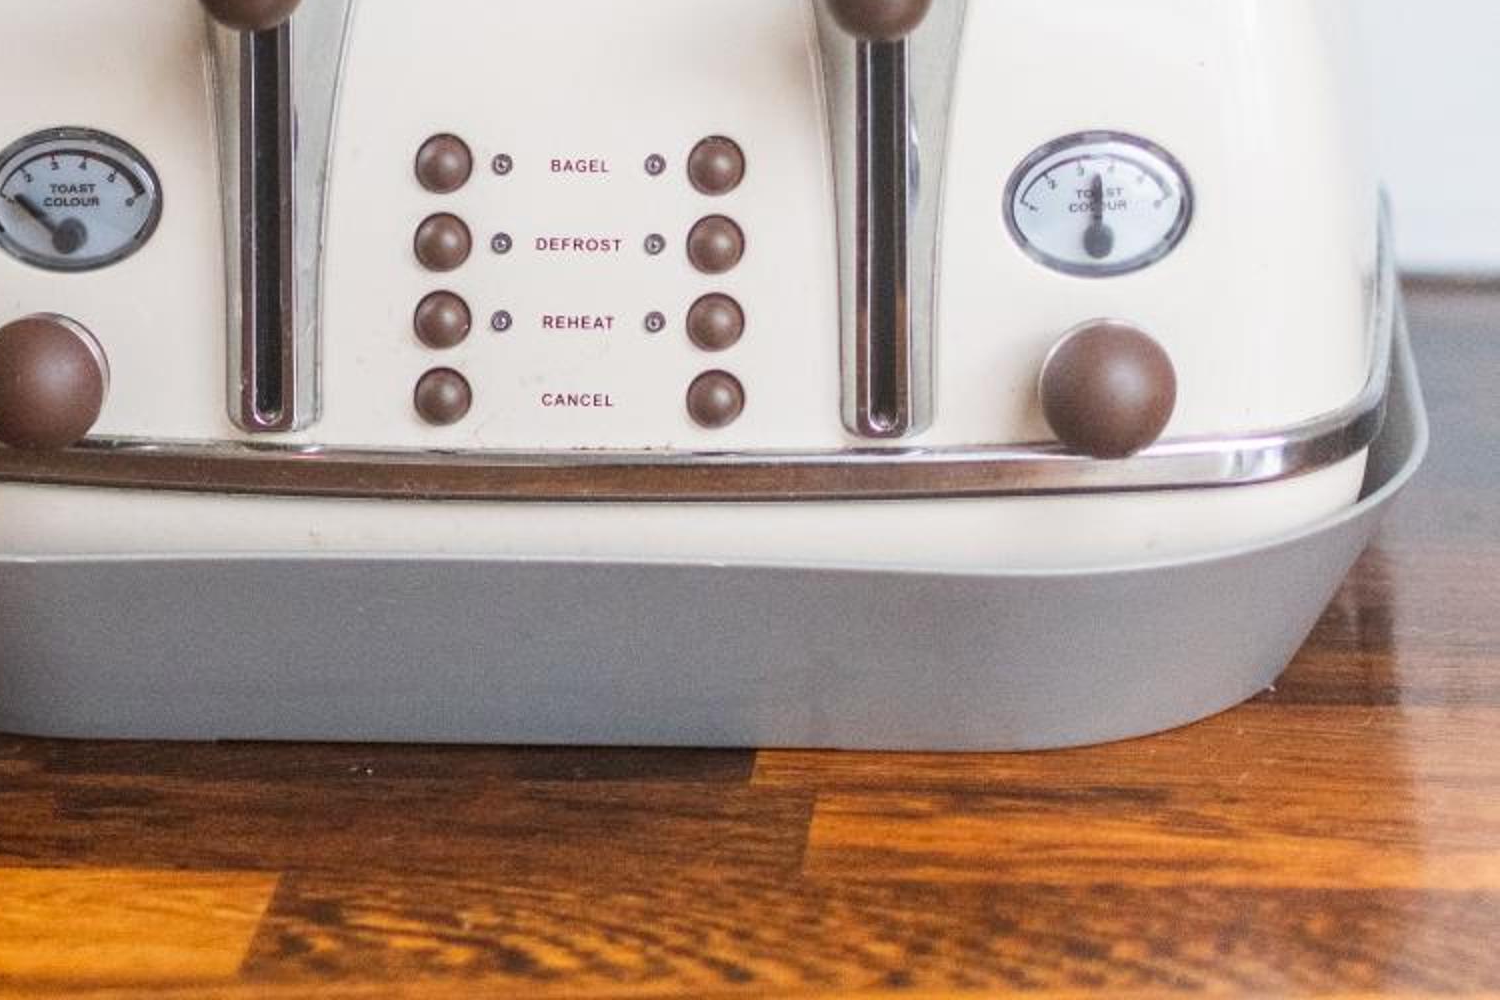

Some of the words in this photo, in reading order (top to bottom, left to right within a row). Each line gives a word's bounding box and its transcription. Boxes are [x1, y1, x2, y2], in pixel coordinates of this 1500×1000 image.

[550, 159, 610, 173] BAGEL
[49, 183, 97, 194] TOAST
[1075, 187, 1125, 199] TOST
[42, 196, 100, 208] COLOUR
[535, 237, 622, 251] DEFROST
[542, 315, 615, 329] REHEAT
[541, 393, 614, 407] CANCEL
